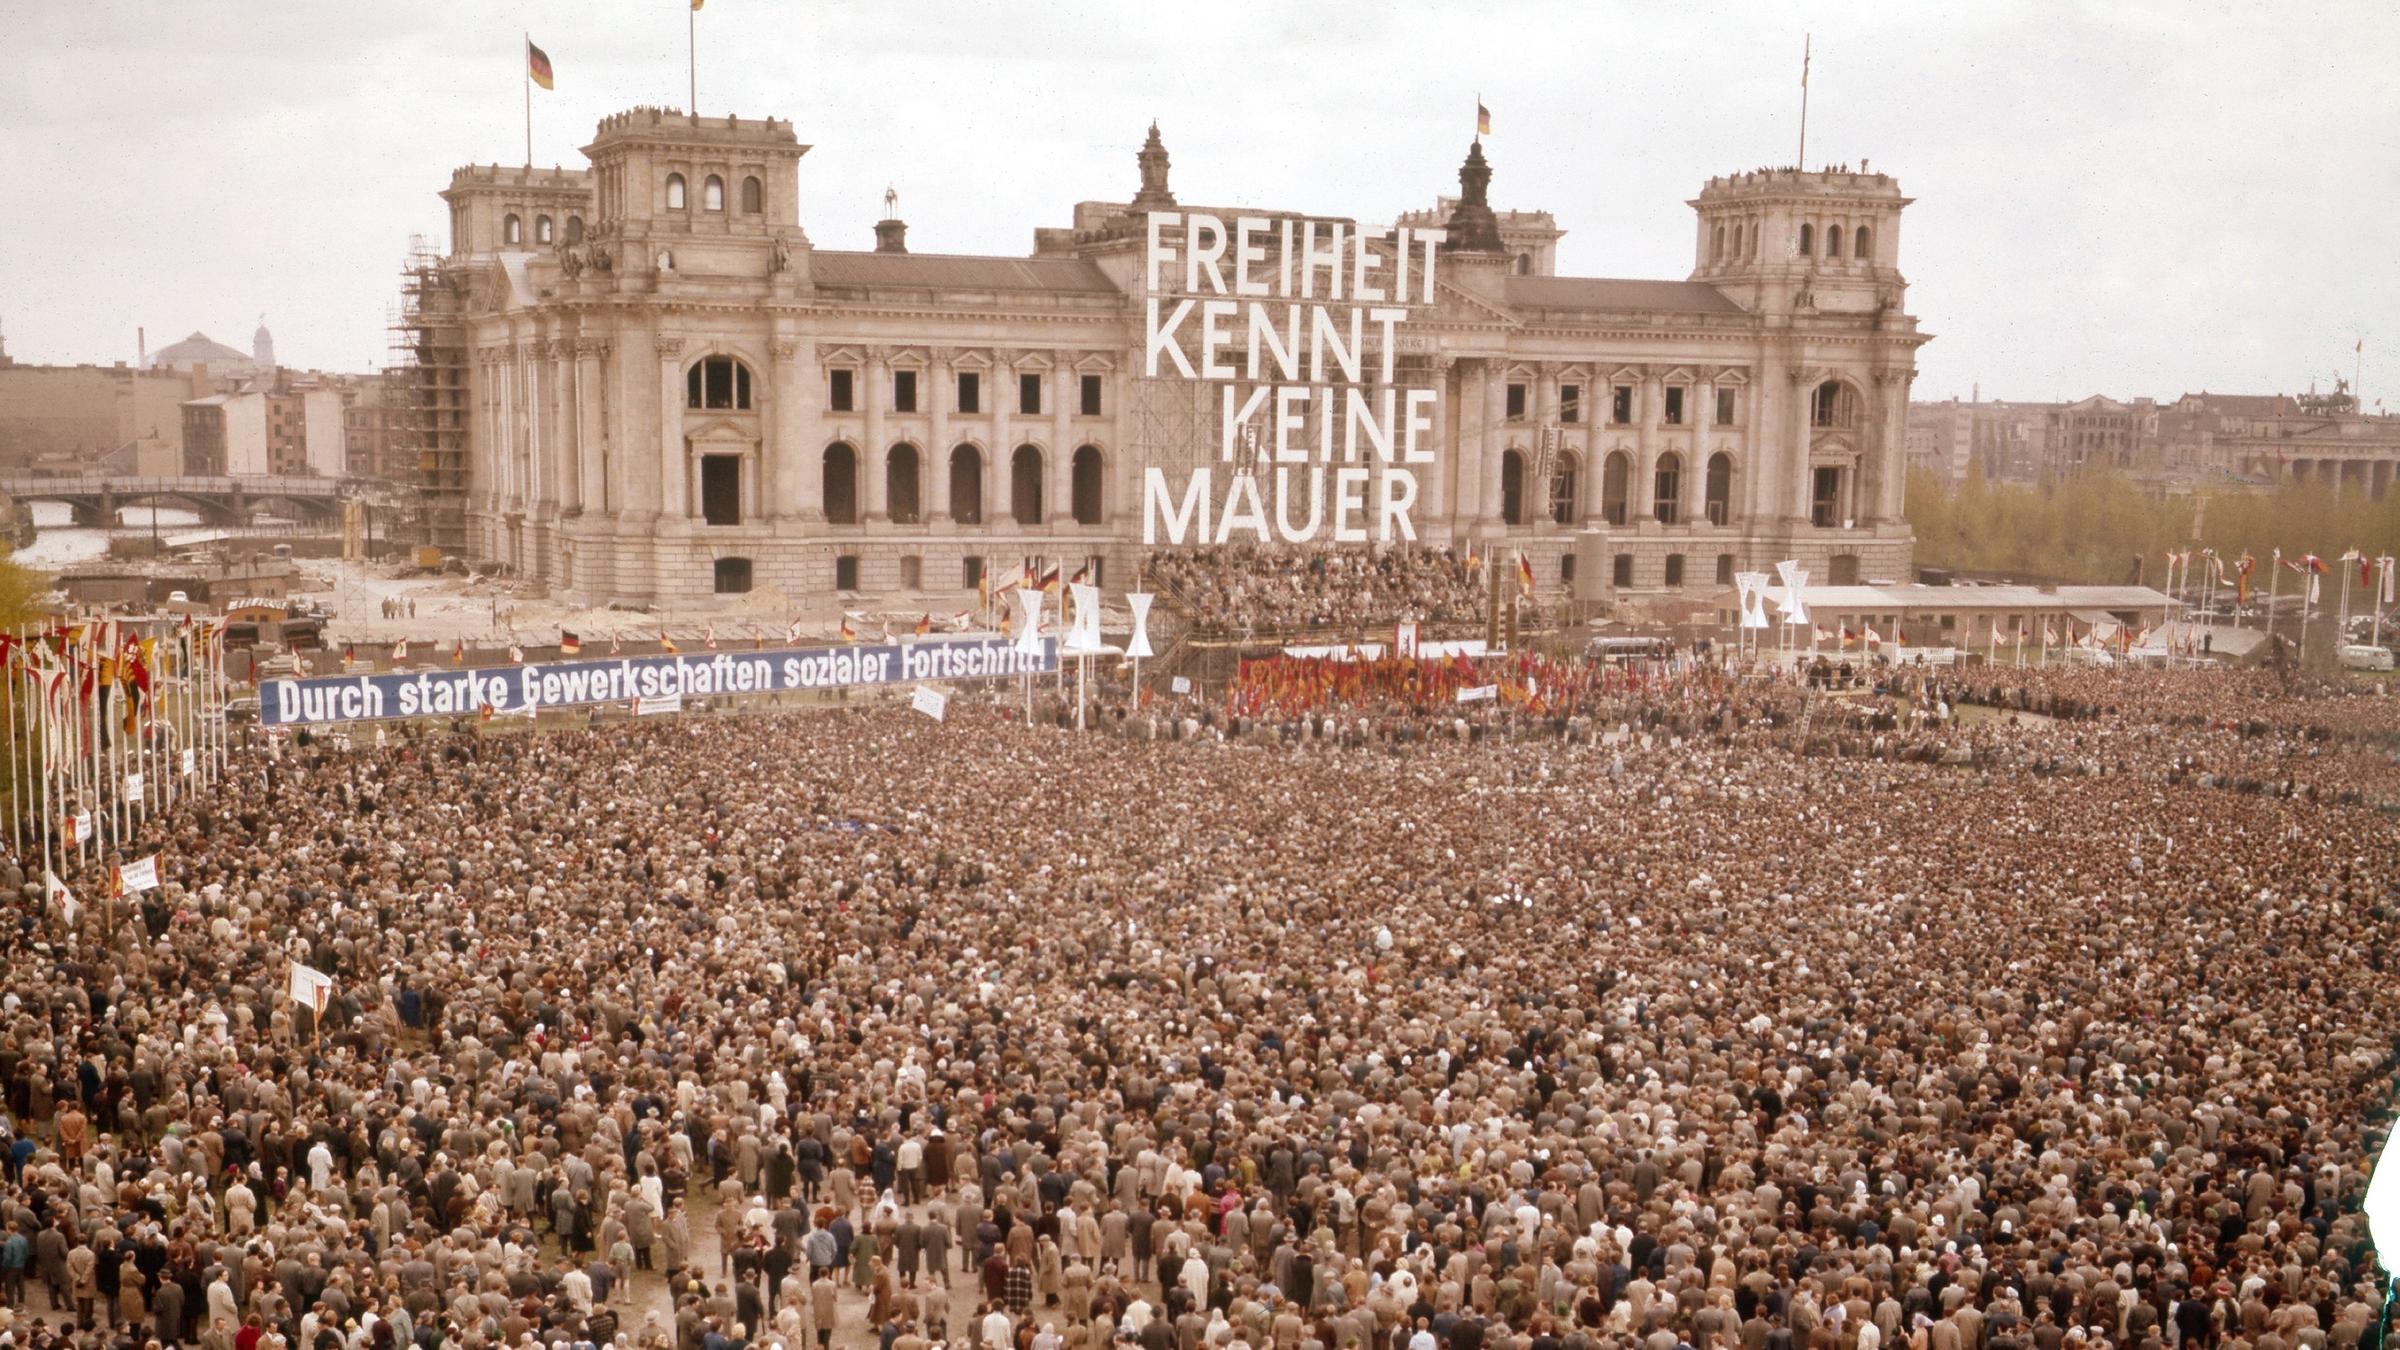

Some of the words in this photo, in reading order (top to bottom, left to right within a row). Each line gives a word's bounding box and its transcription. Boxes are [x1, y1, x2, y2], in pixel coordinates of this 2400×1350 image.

[1147, 211, 1447, 304] FREIHEIT
[1146, 298, 1407, 383] KENNT
[1222, 385, 1437, 462] KEINE
[1143, 467, 1417, 544] MAUER
[278, 676, 383, 722] Durch
[399, 670, 508, 714] starke
[521, 654, 772, 704] Gewerkschaften
[784, 648, 890, 687] sozialer
[902, 638, 1045, 680] Fortschritt!
